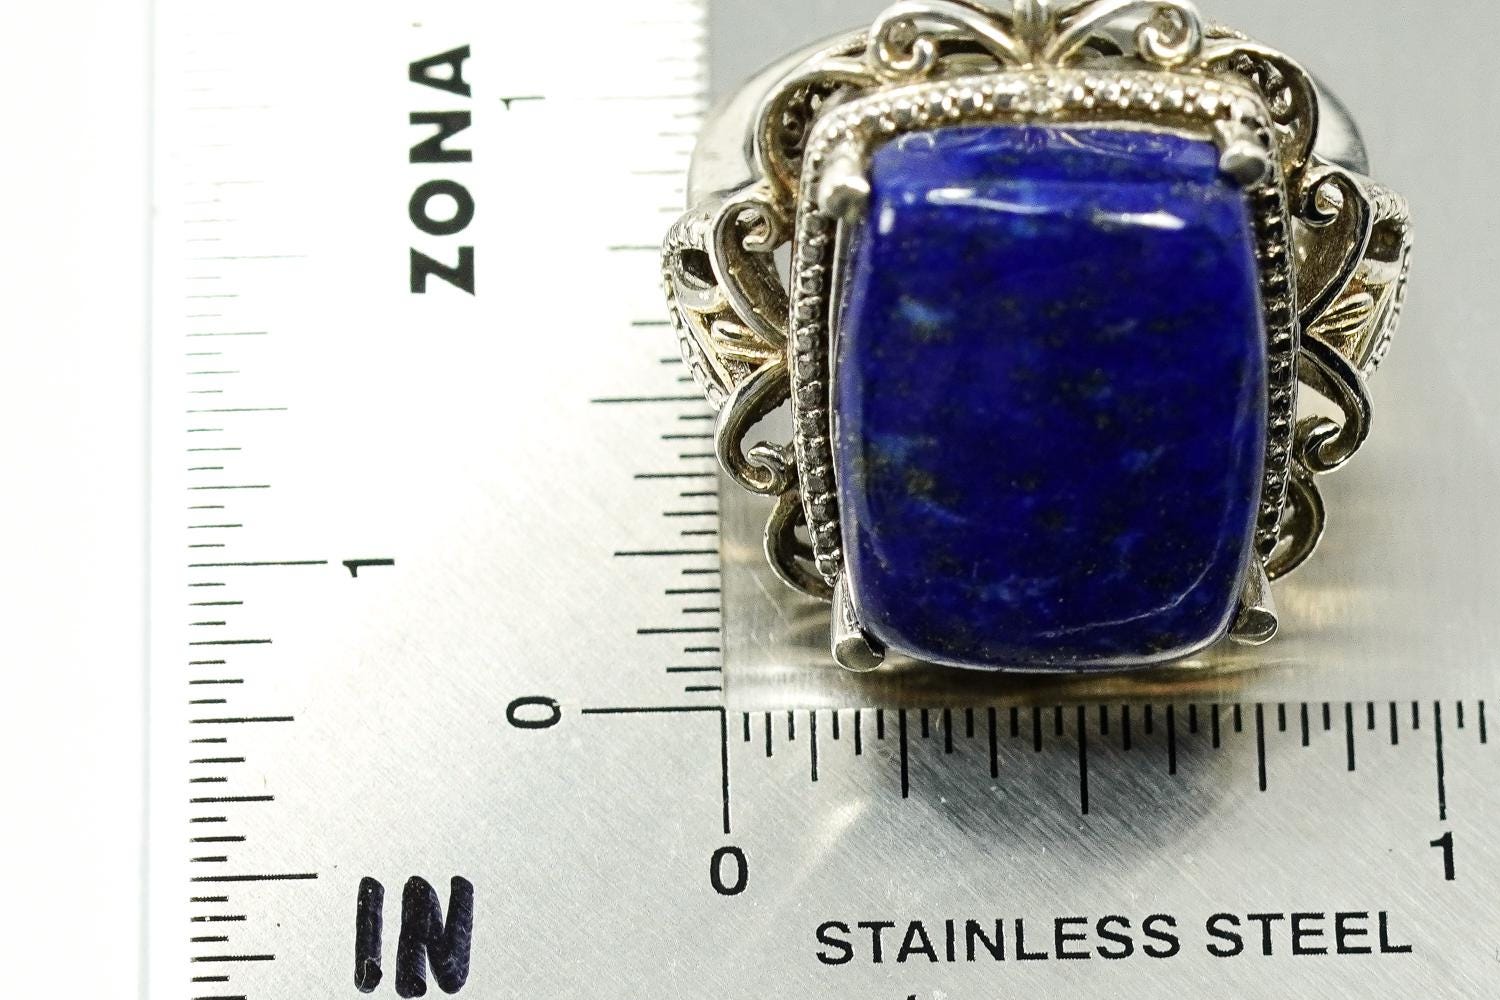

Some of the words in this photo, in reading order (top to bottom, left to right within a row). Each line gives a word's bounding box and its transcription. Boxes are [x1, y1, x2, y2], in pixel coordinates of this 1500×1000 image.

[409, 44, 476, 296] ZONA
[342, 558, 395, 578] 1
[505, 696, 562, 730] 0
[709, 846, 749, 896] 0
[1429, 831, 1456, 881] 1
[354, 875, 474, 999] IN
[815, 913, 1181, 966] STAINLESS
[1205, 910, 1413, 958] STEEL
